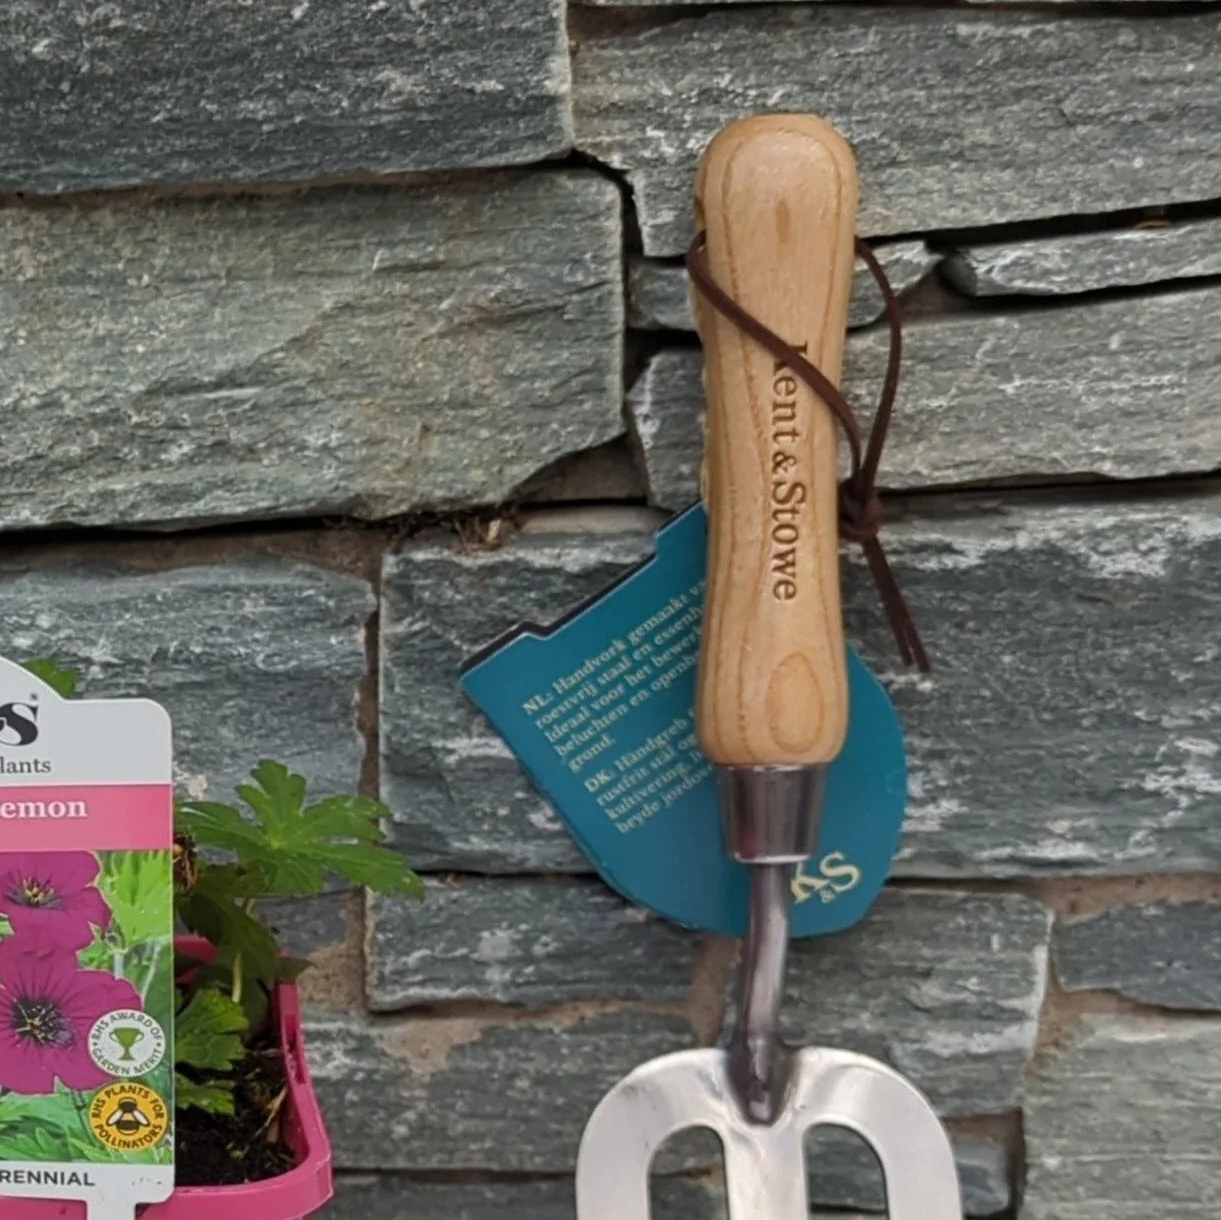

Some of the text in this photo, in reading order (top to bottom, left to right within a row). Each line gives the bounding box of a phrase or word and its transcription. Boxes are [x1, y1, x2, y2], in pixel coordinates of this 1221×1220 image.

[772, 482, 807, 601] Stowe
[110, 1012, 154, 1028] AWARD
[150, 1027, 163, 1041] OF
[92, 1048, 162, 1075] GARDEN MERIT
[91, 1085, 165, 1119] RHS PLANTS FOR
[94, 1124, 163, 1150] POLLINATORS
